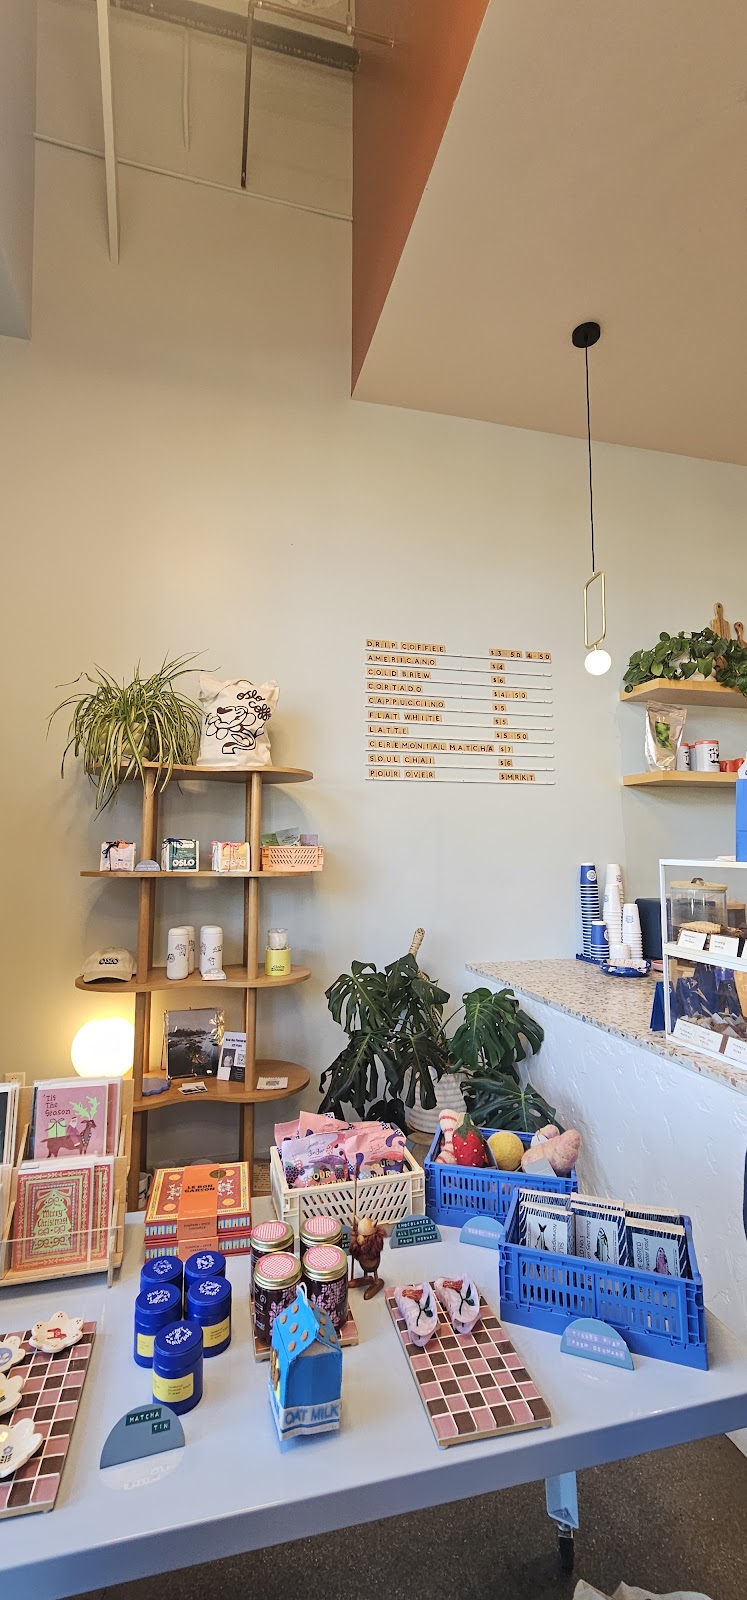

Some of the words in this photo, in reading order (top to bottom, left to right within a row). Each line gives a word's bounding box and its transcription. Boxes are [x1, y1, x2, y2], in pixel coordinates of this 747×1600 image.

[366, 640, 396, 649] DRIP
[401, 643, 444, 653] COFFEE
[367, 654, 436, 666] AMERICANO
[492, 663, 504, 671] $4
[367, 668, 397, 677] COLD
[401, 671, 430, 679] BREW
[368, 683, 422, 693] CORTADO
[368, 697, 444, 708] CAPPUCCINO
[369, 712, 399, 720] FLAT
[404, 714, 441, 722] WHITE
[369, 726, 408, 735] LATTE
[369, 740, 446, 751] CEREMONIAL
[449, 744, 494, 752] MATCHA
[369, 755, 399, 763] SOUL
[404, 756, 433, 764] CHAI
[370, 770, 399, 778] POUR
[405, 771, 434, 779] OVER
[500, 773, 534, 781] $MRKT
[172, 858, 196, 868] OSLO
[44, 1101, 58, 1109] The
[44, 1109, 71, 1117] Season
[307, 1170, 332, 1182] SOUR
[42, 1209, 64, 1218] Merry
[416, 1234, 436, 1242] NORWAY
[572, 1330, 598, 1342] TINNED
[603, 1338, 621, 1348] FISH
[571, 1339, 589, 1348] FROM
[592, 1345, 624, 1358] DENMARK
[128, 1411, 160, 1424] MATCHA
[285, 1408, 306, 1425] OAT
[310, 1405, 340, 1422] MILK
[153, 1423, 169, 1431] TIN
